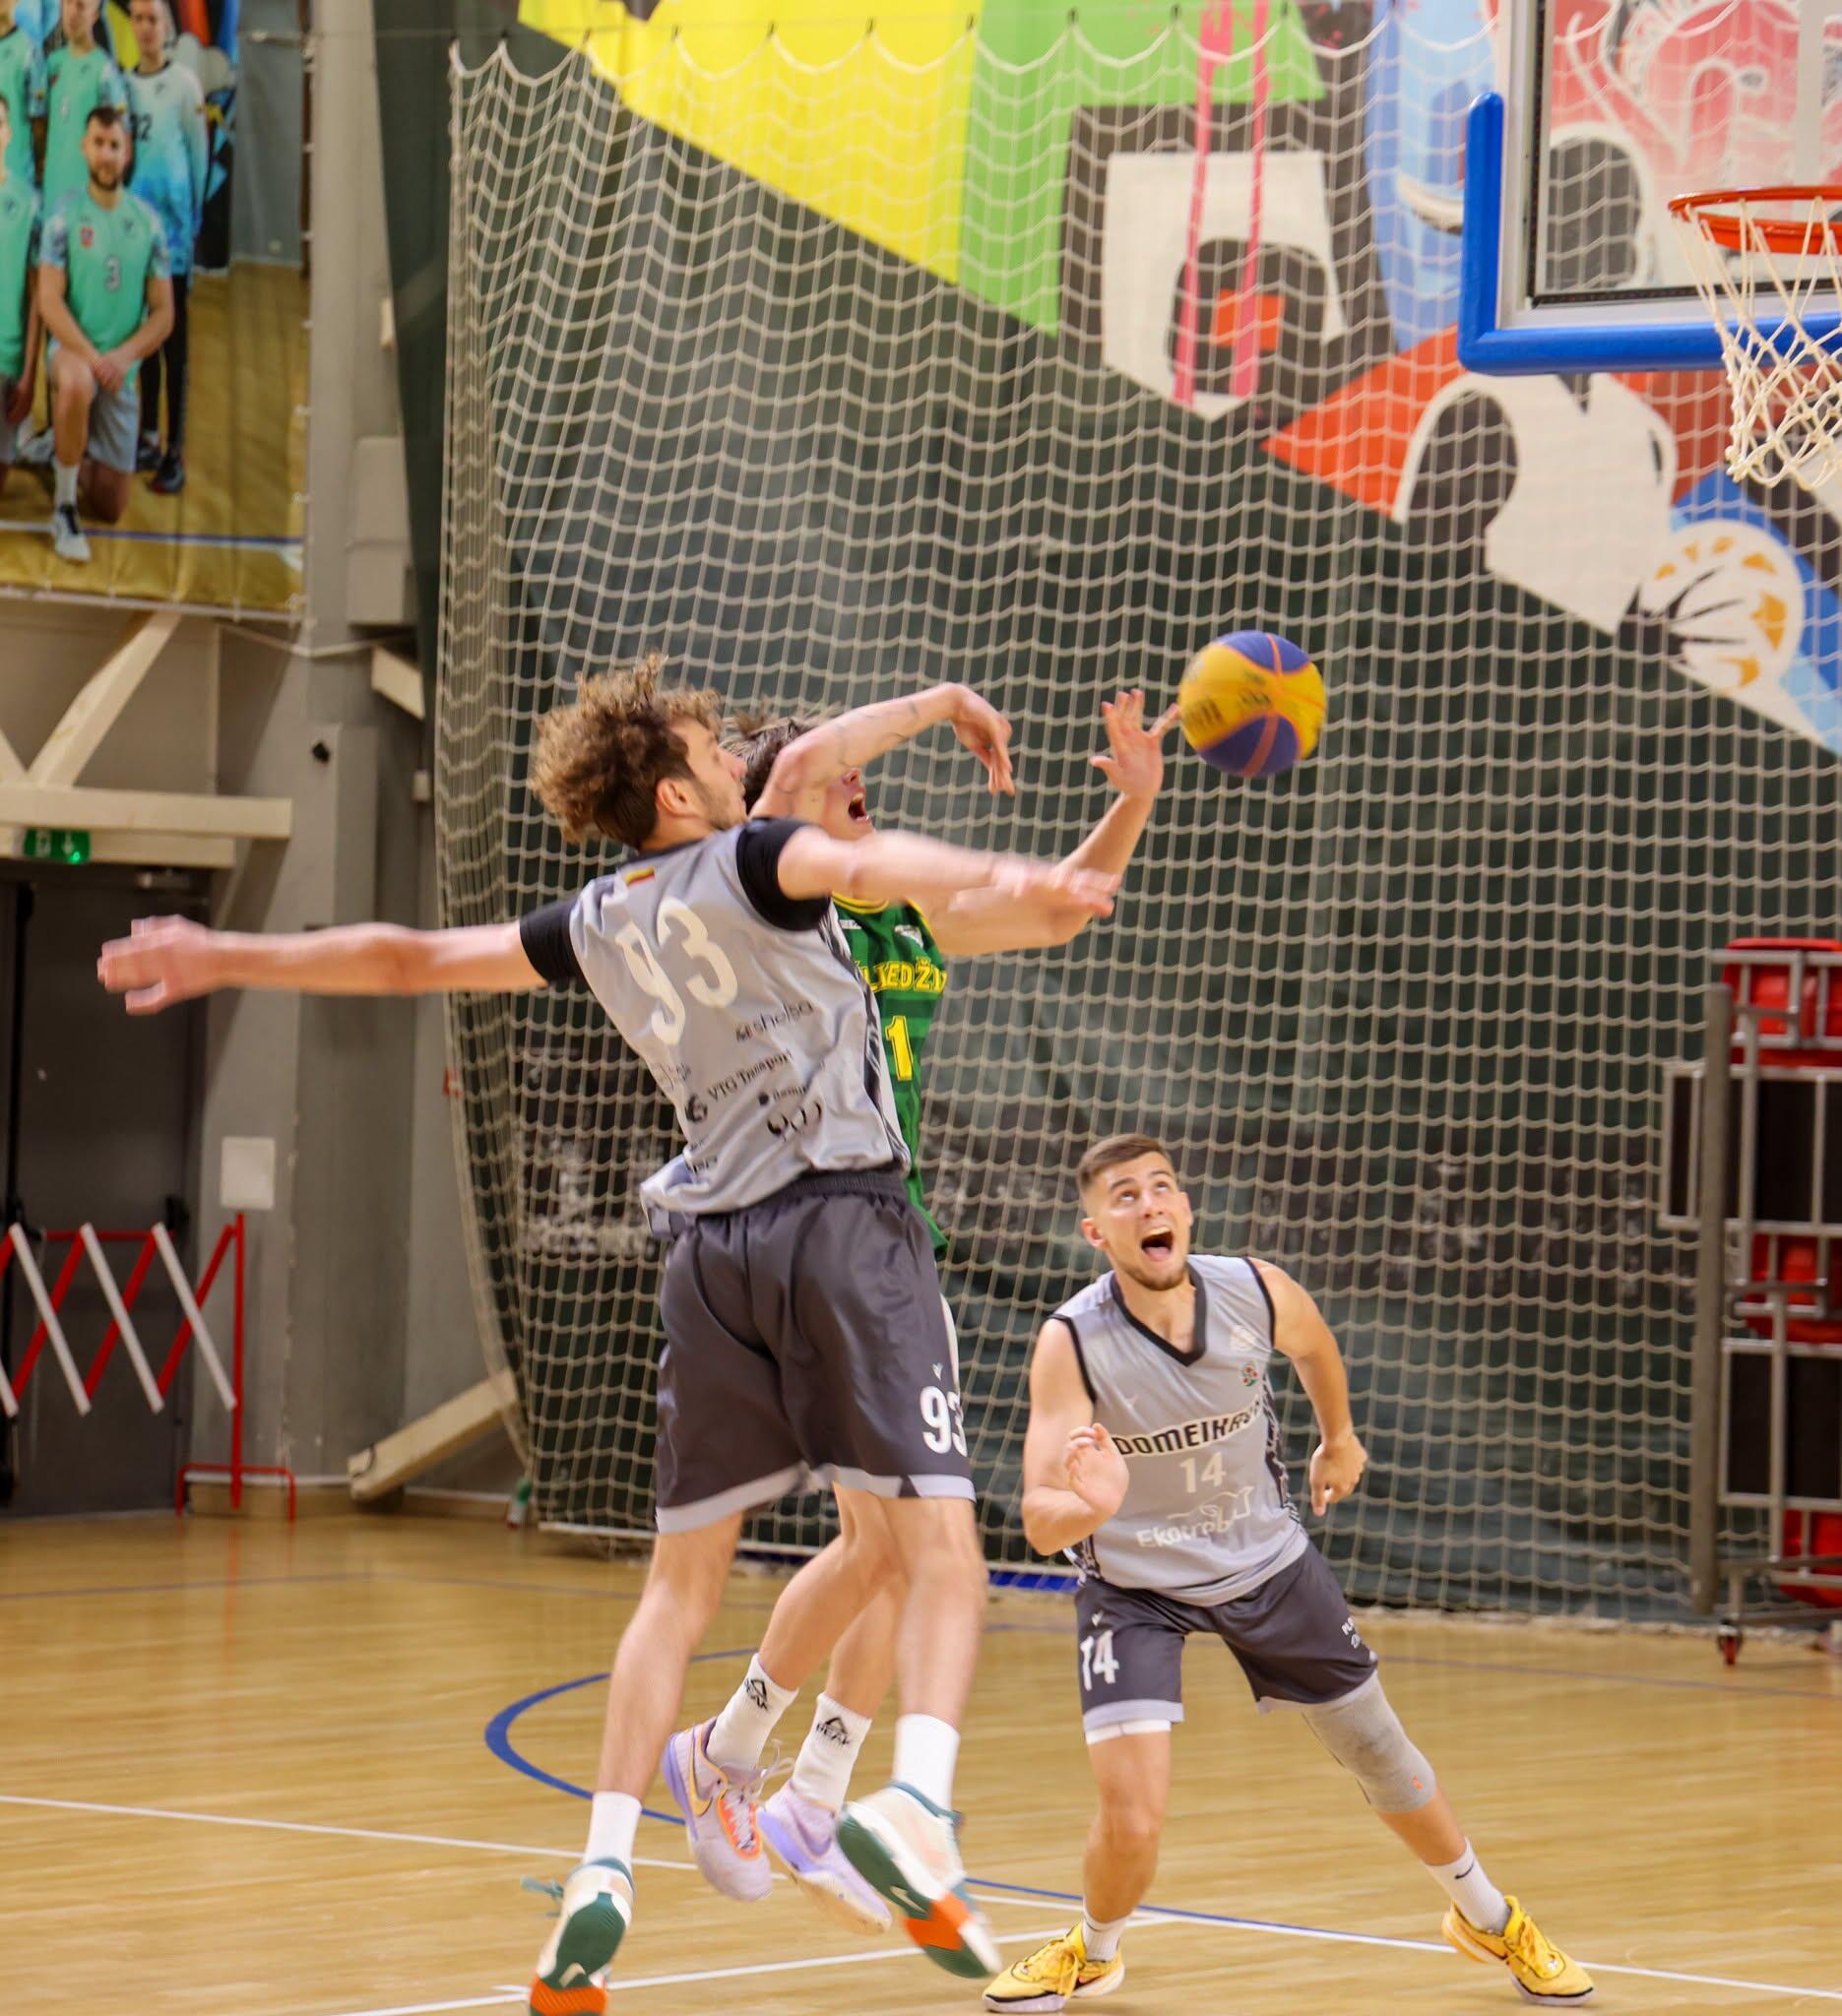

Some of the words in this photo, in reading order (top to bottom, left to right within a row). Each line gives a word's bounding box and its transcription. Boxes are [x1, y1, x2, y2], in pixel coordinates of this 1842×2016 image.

[614, 897, 738, 1046] 93
[1178, 1450, 1227, 1494] 14
[1079, 1628, 1120, 1691] 14
